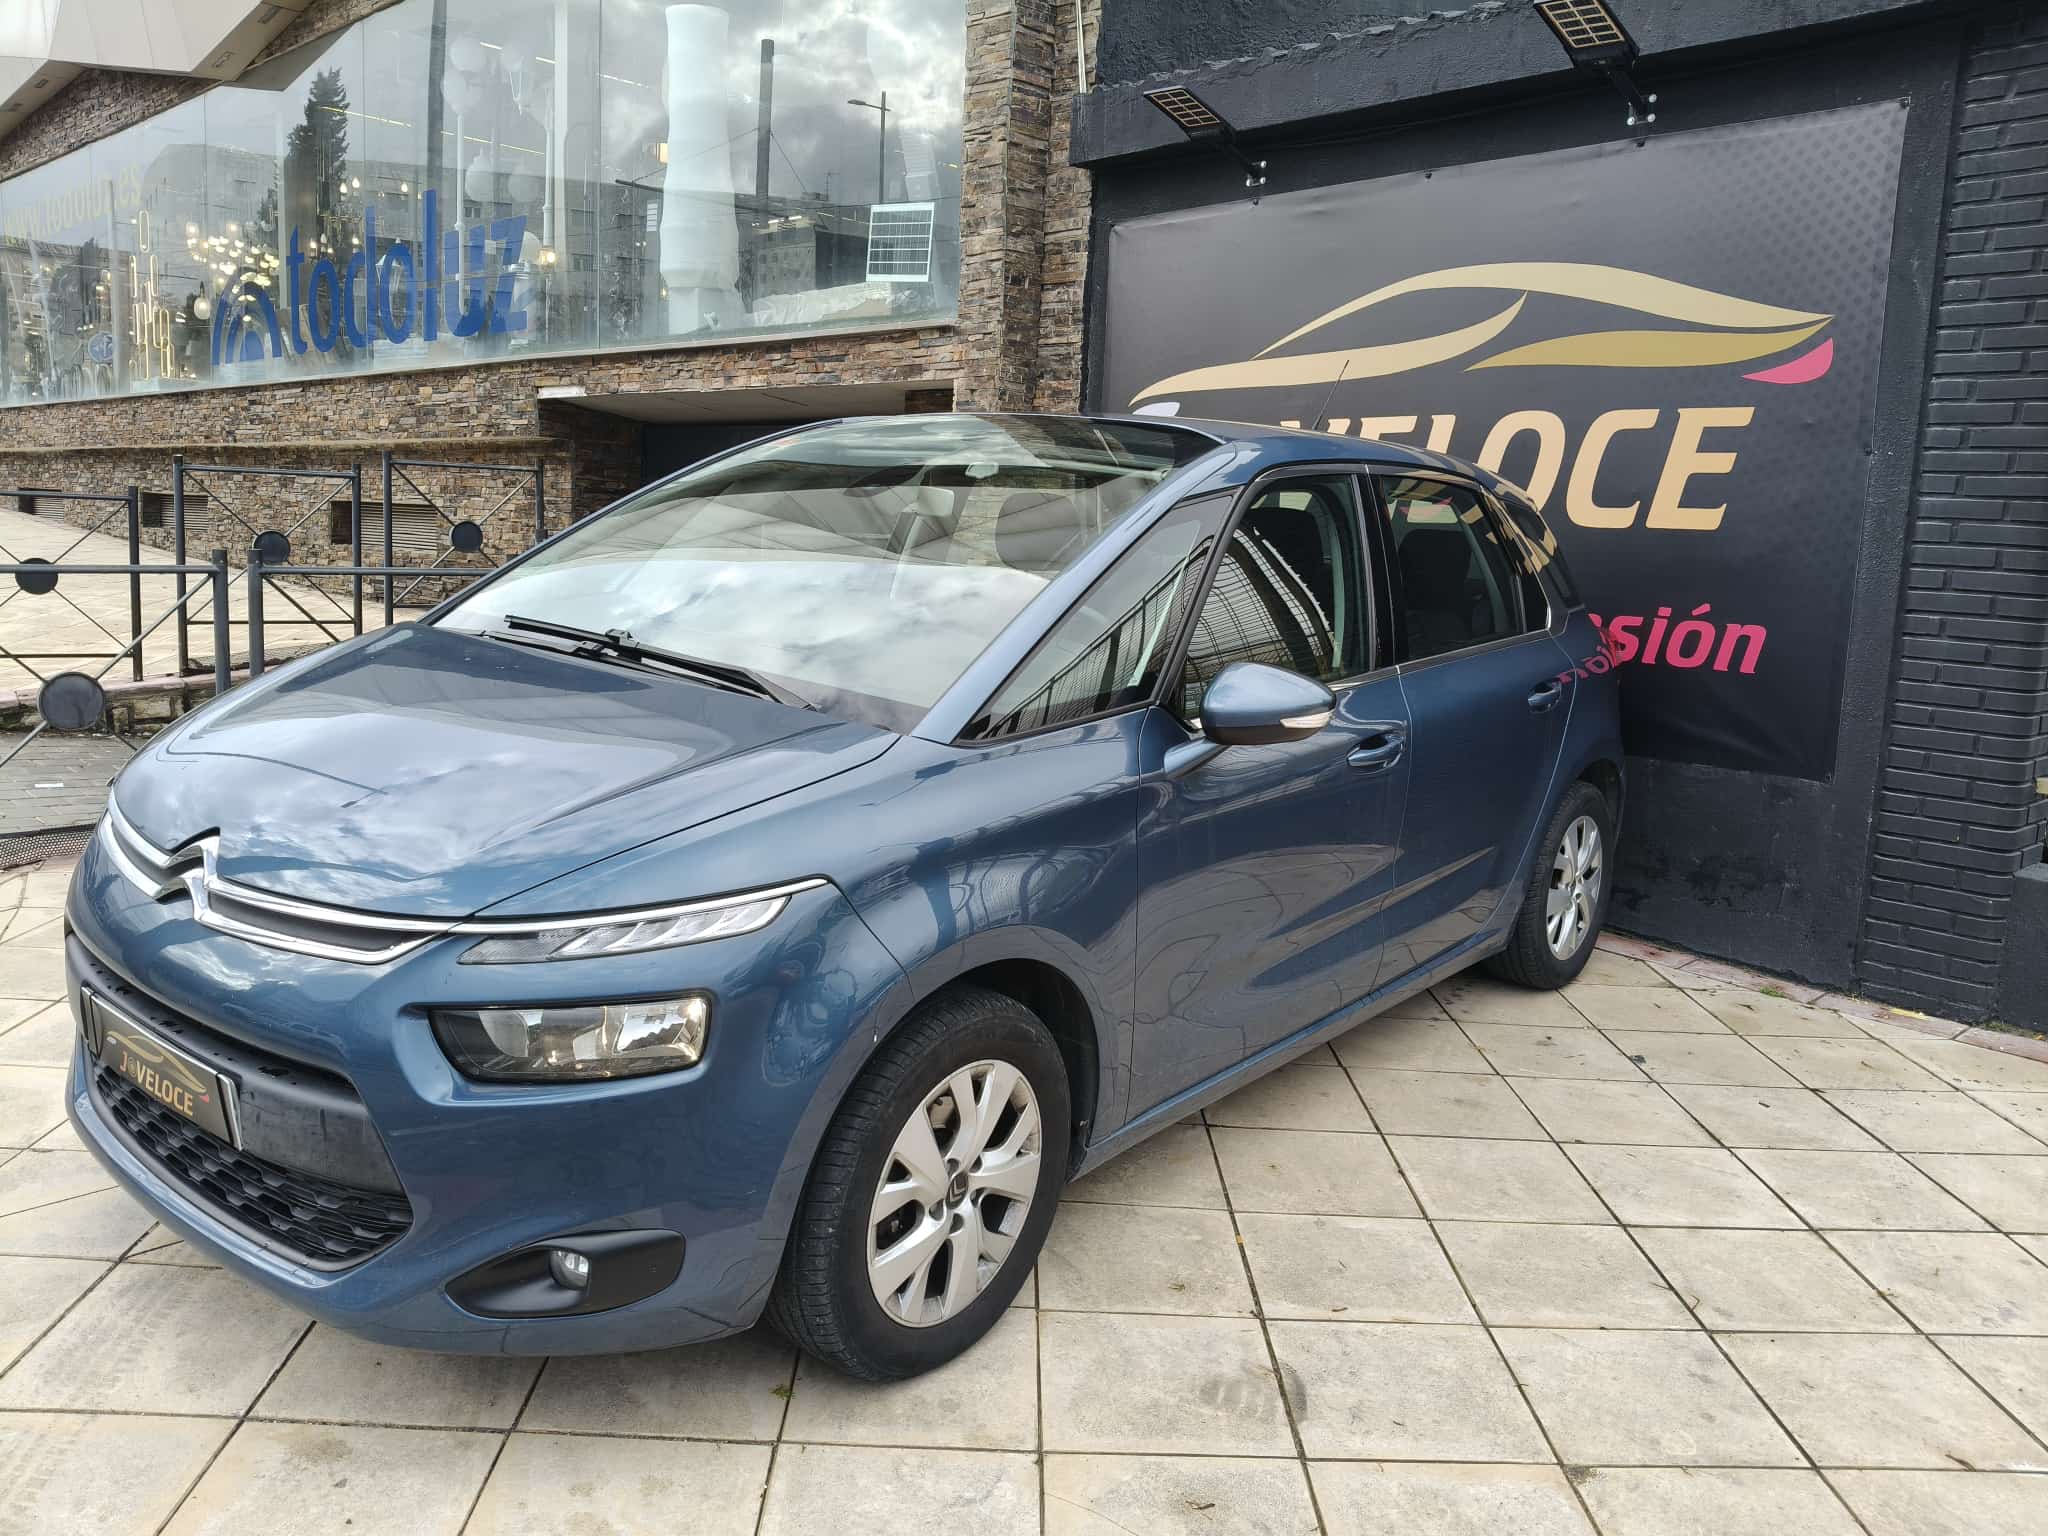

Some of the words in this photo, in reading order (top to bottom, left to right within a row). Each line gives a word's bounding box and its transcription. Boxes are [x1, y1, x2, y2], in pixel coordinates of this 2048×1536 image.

[286, 189, 527, 355] todoluz
[1280, 406, 1755, 531] OCE
[1588, 603, 1767, 674] sión
